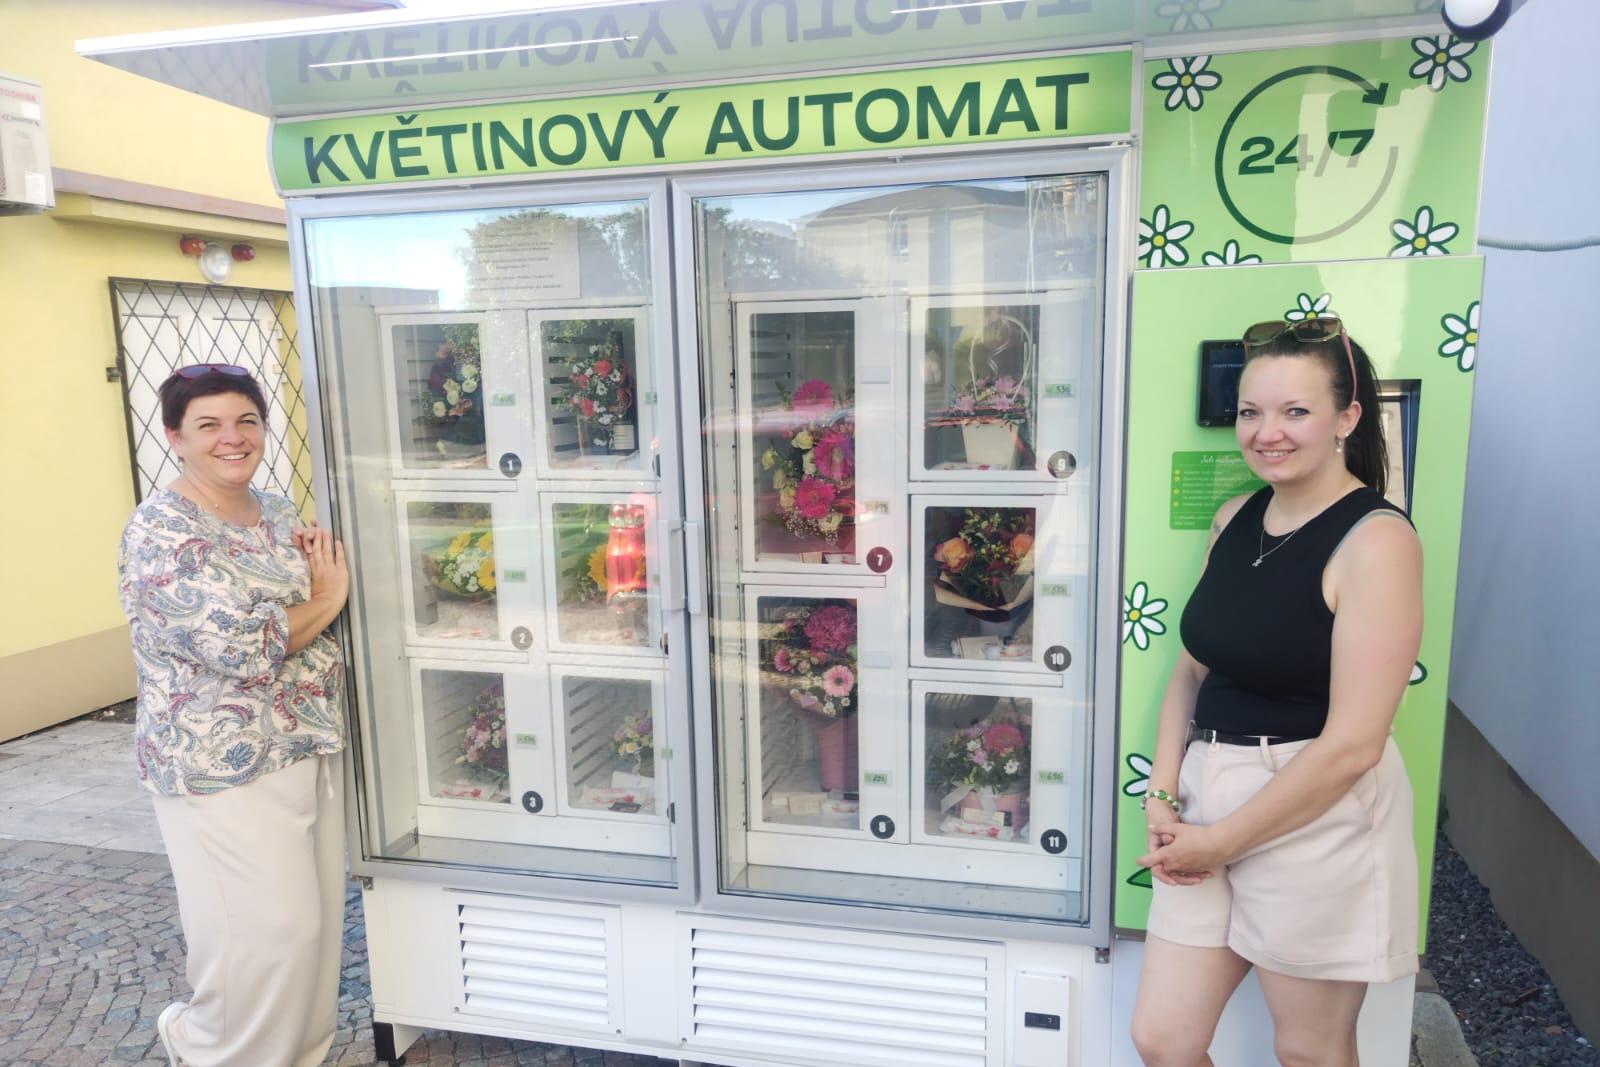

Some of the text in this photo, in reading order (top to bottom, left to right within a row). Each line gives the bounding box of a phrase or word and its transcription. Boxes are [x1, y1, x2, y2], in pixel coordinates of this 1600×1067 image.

[303, 72, 1090, 184] KVĚTINOVÝ AUTOMAT
[1238, 128, 1375, 177] 24/7
[506, 459, 513, 471] 1
[876, 554, 884, 566] 7
[519, 632, 526, 644] 2
[1050, 652, 1065, 665] 10
[1047, 836, 1060, 848] 11
